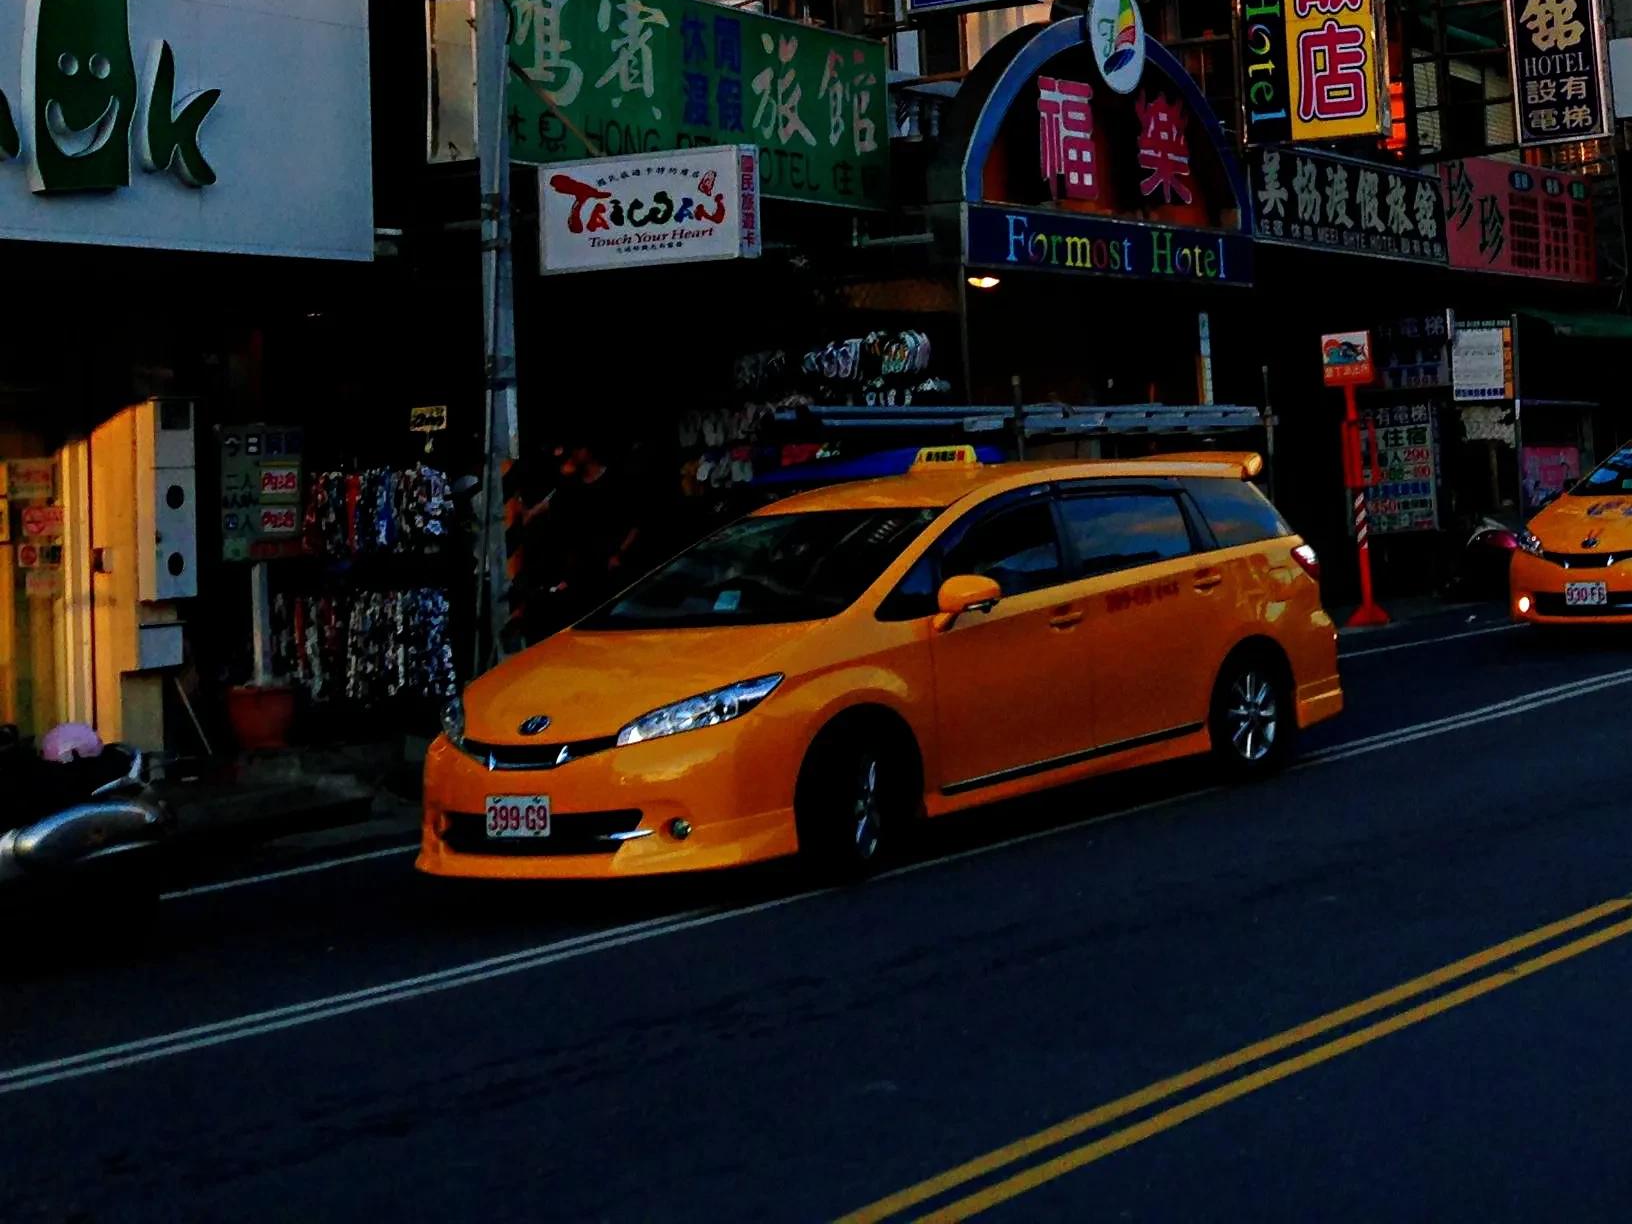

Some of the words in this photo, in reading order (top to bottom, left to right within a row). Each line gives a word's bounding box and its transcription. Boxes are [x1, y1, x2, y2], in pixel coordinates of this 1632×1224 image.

[1524, 52, 1590, 77] HOTEL
[751, 32, 880, 156] 旅館
[1037, 75, 1193, 205] 福樂
[588, 233, 633, 249] Touch
[636, 231, 669, 245] Your
[671, 226, 714, 241] Heart
[1005, 214, 1133, 272] Formost
[1152, 231, 1227, 280] Hotel
[487, 805, 547, 831] 399-G9
